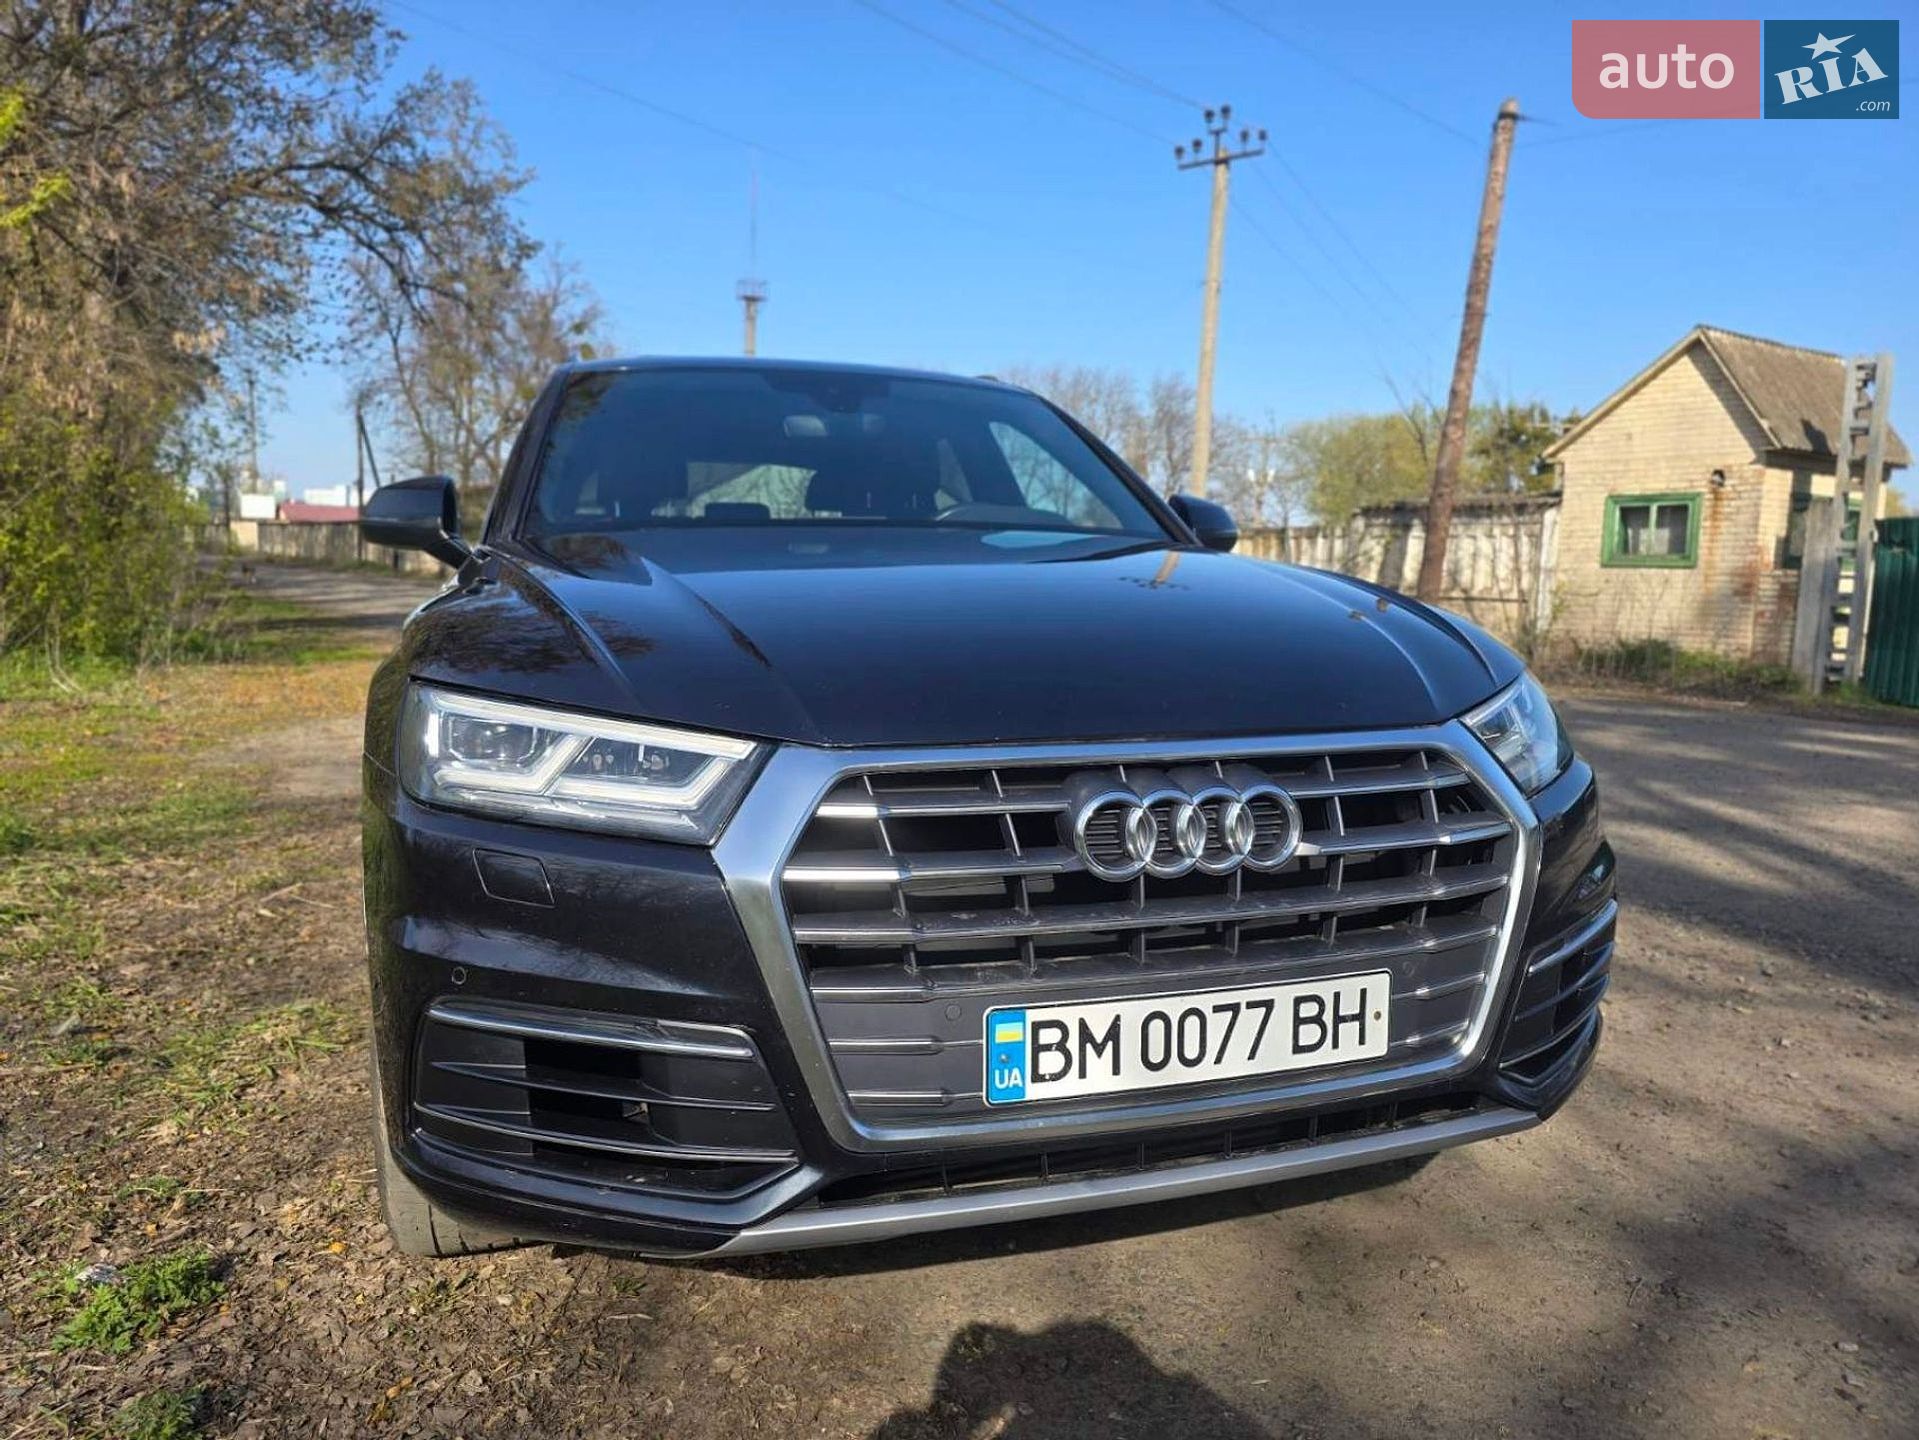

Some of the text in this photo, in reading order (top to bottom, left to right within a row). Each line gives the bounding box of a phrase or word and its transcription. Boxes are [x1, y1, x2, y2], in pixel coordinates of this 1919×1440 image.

[1030, 987, 1368, 1083] BM 0077 BH
[994, 1068, 1023, 1090] UA
